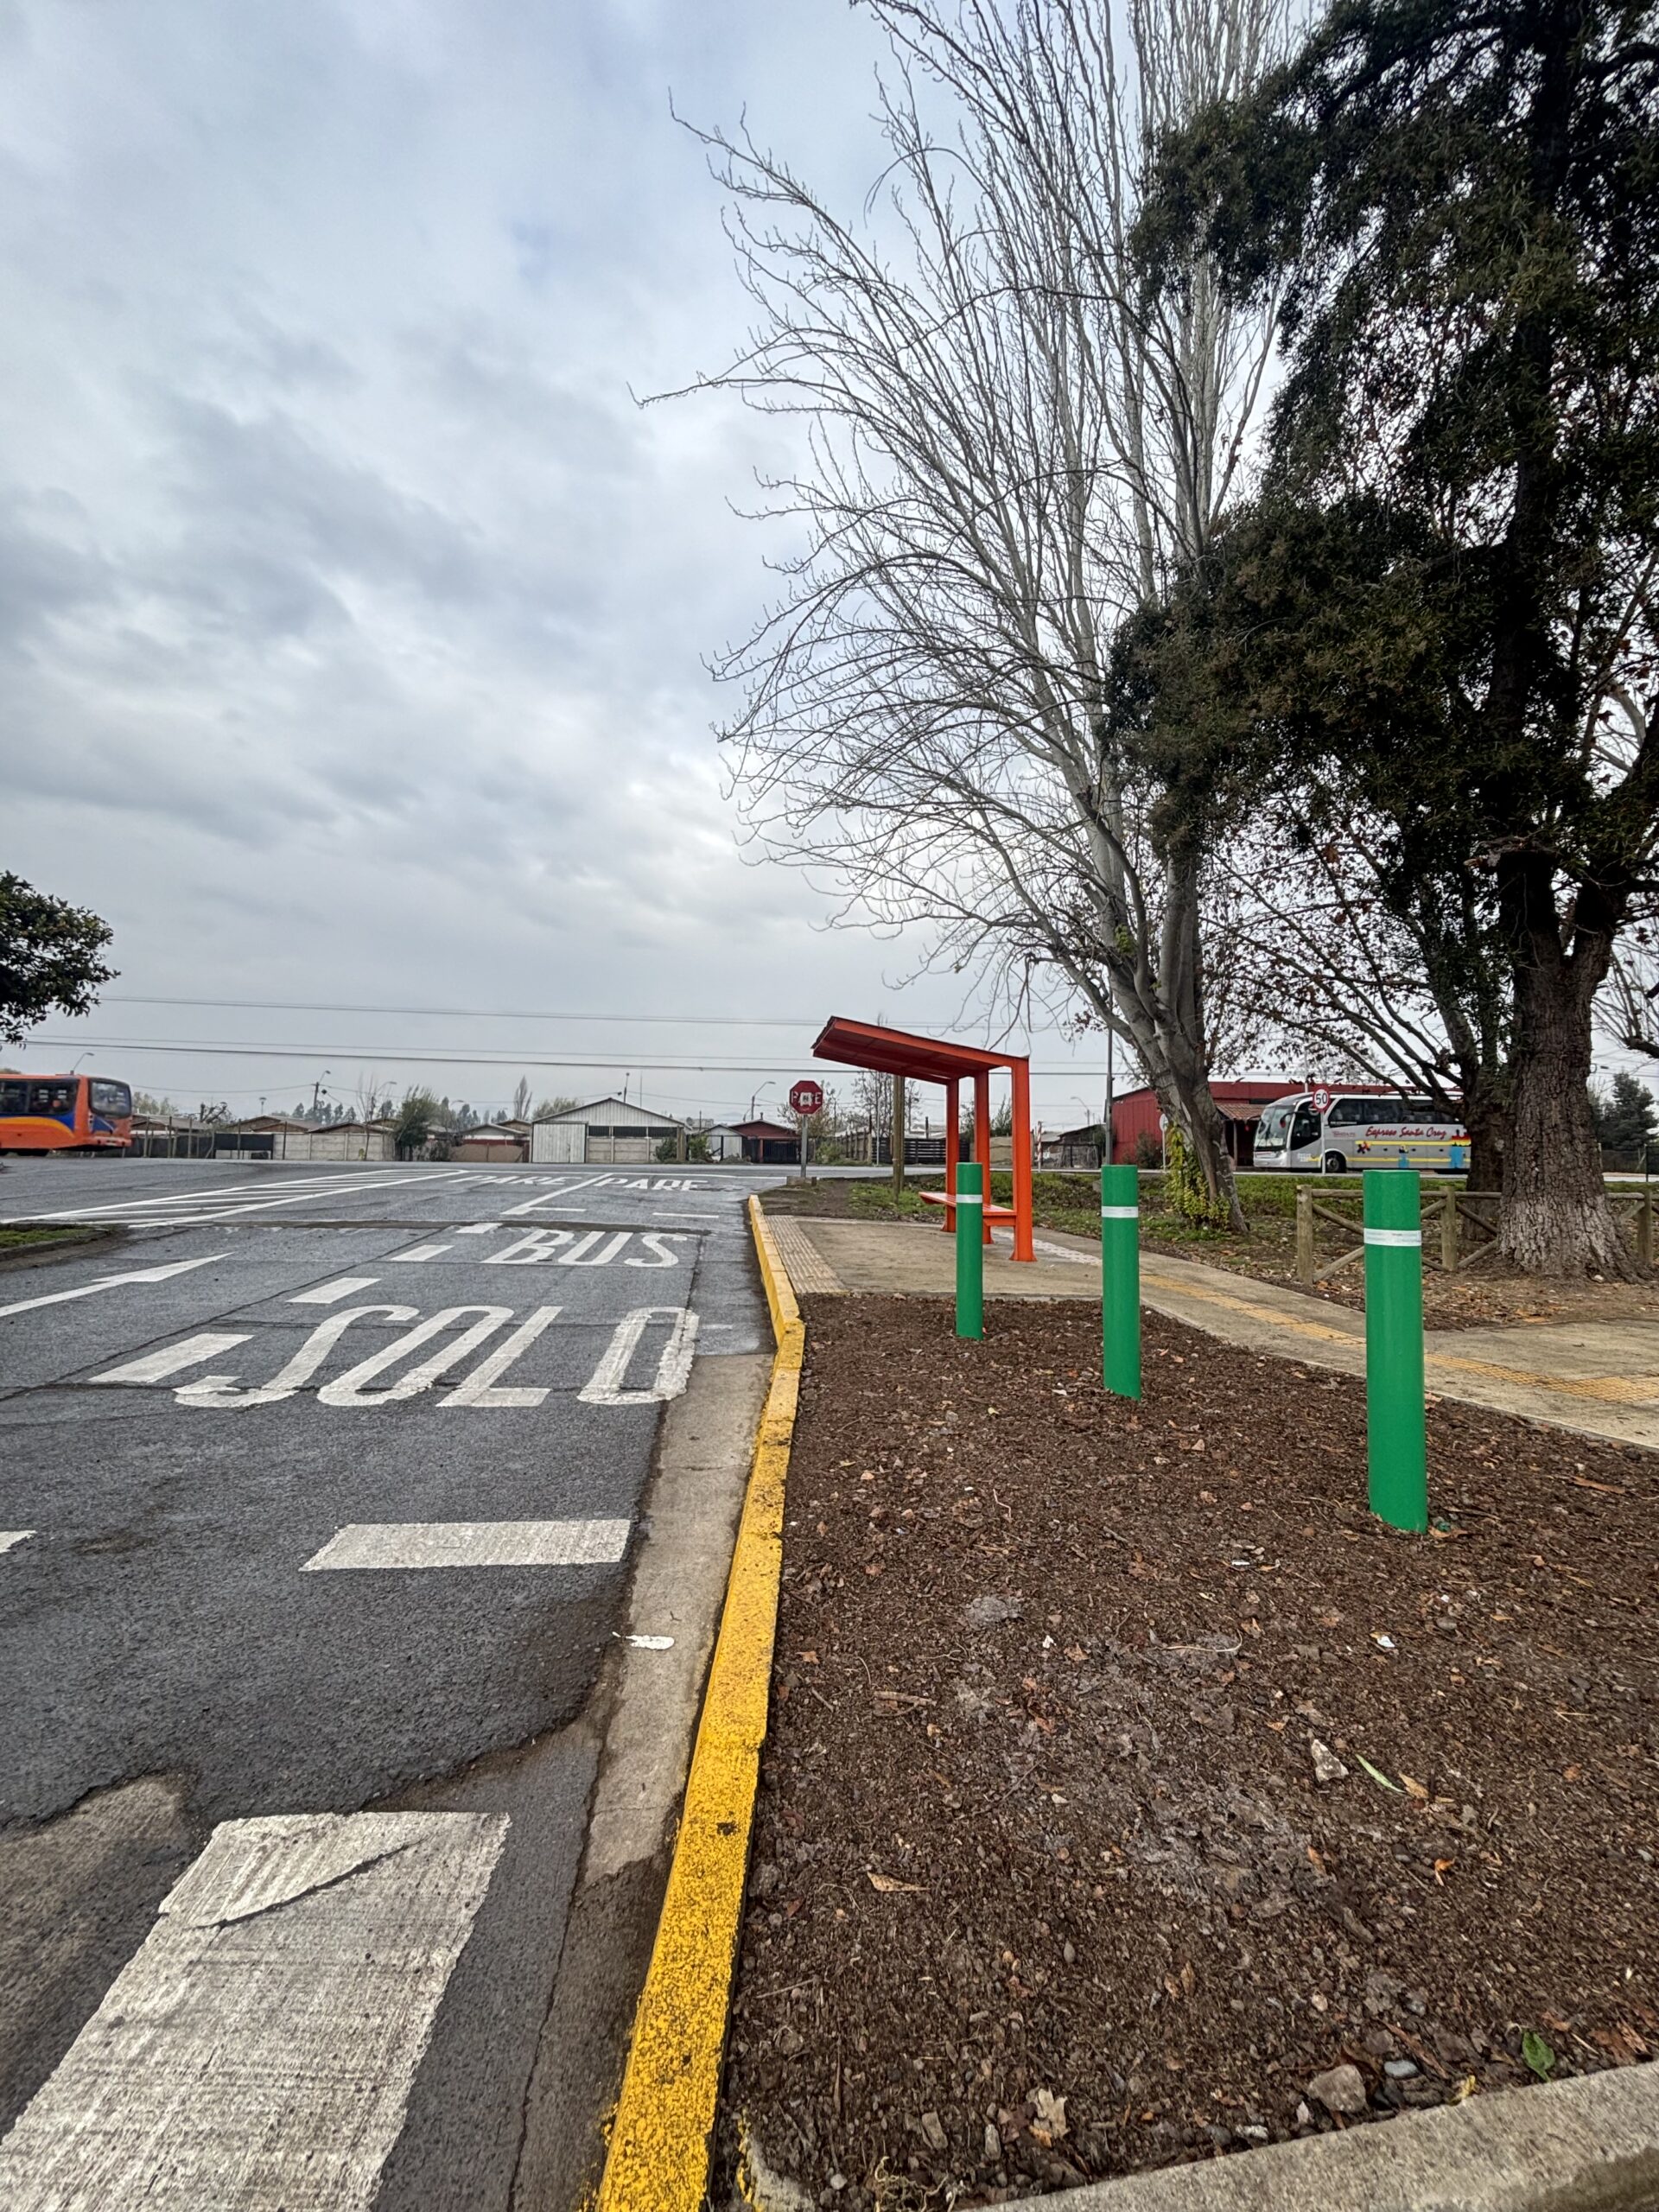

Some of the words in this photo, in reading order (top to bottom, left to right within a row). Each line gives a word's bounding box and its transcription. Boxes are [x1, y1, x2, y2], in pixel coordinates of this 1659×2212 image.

[791, 1090, 822, 1105] PE
[1315, 1092, 1328, 1105] 50
[1399, 1126, 1424, 1137] Santa
[1426, 1127, 1447, 1140] Cruz
[449, 1175, 582, 1185] PARE
[593, 1177, 710, 1192] PARE
[480, 1228, 688, 1268] BUS
[173, 1306, 701, 1408] SOLO
